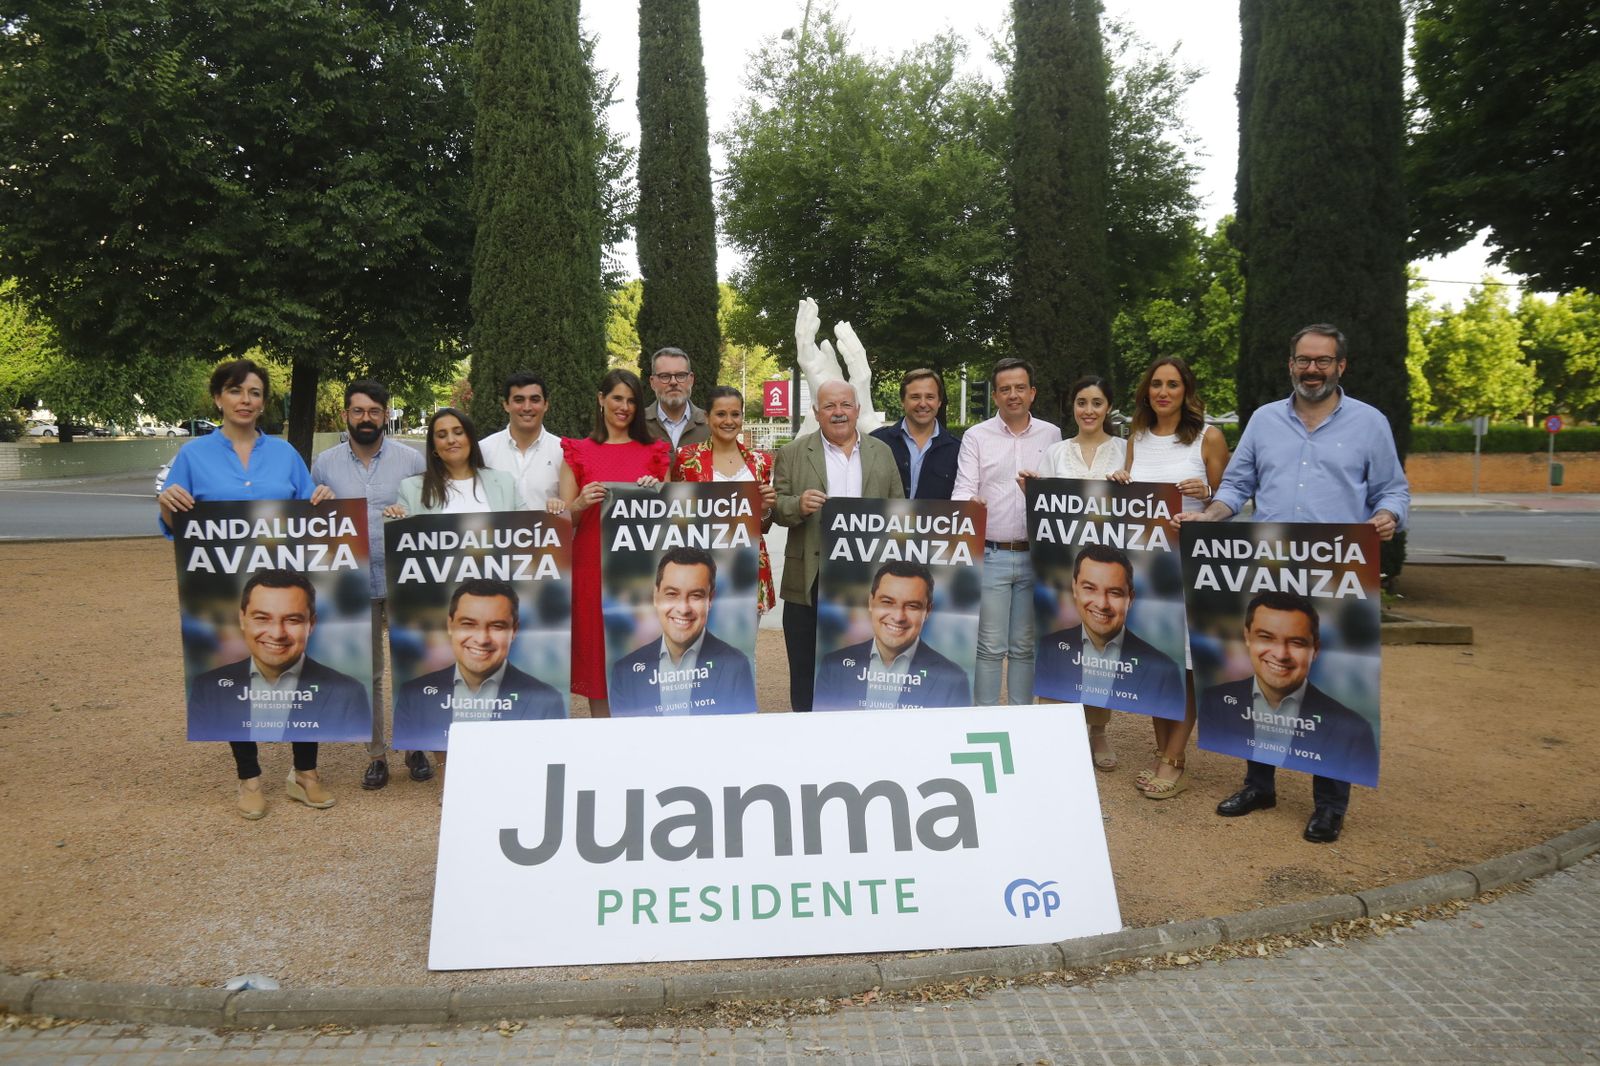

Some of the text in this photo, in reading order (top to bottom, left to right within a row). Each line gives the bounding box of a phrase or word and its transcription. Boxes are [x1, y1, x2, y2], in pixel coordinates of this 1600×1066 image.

[611, 492, 752, 519] ANDALUCÍA
[1034, 493, 1171, 520] ANDALUCÍA
[183, 510, 358, 540] ANDALUCÍA
[831, 511, 975, 535] ANDALUCÍA
[1036, 518, 1171, 552] AVANZA
[396, 522, 561, 551] ANDALUCÍA
[611, 523, 751, 552] AVANZA
[186, 543, 358, 574] AVANZA
[829, 538, 973, 566] AVANZA
[1192, 535, 1366, 564] ANDALUCÍA
[398, 554, 561, 584] AVANZA
[1194, 565, 1367, 600] AVANZA
[1072, 651, 1133, 673] Juanma
[1084, 669, 1124, 679] PRESIDENTE
[649, 665, 708, 685] Juanma
[662, 682, 701, 692] PRESIDENTE
[857, 667, 921, 685] Juanma
[237, 686, 312, 701] Juanma
[870, 684, 911, 692] PRESIDENTE
[1085, 685, 1108, 695] JUNIO
[1116, 691, 1138, 700] VOTA
[440, 694, 512, 711] Juanma
[664, 702, 688, 712] JUNIO
[694, 699, 715, 707] VOTA
[869, 701, 893, 709] JUNIO
[1241, 706, 1315, 731] Juanma
[1257, 724, 1305, 737] PRESIDENTE
[1246, 738, 1321, 761] 19 JUNIO VOTA
[498, 763, 980, 867] Juanma
[597, 877, 919, 926] PRESIDENTE
